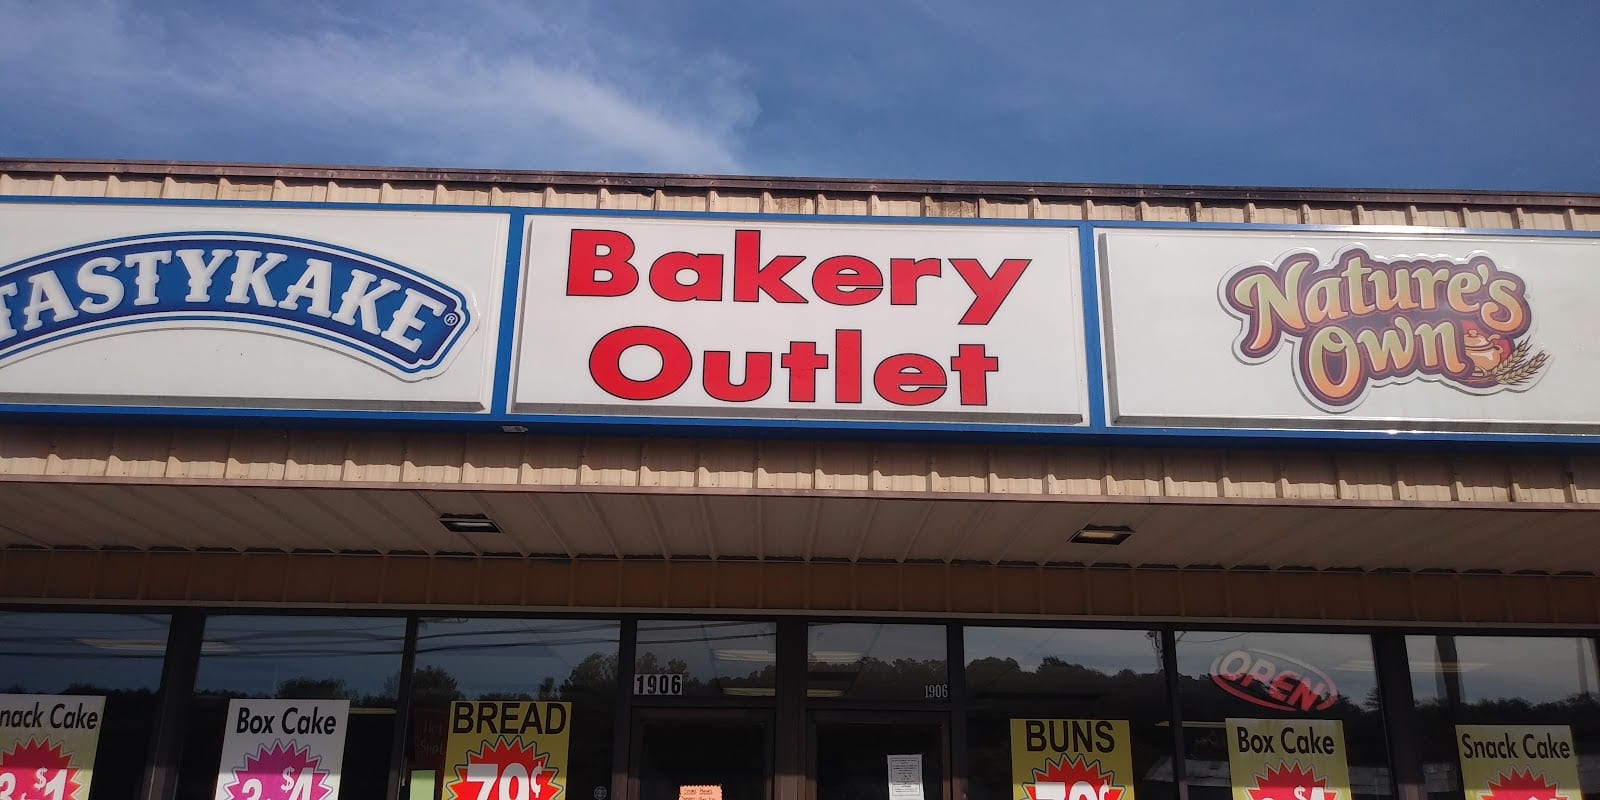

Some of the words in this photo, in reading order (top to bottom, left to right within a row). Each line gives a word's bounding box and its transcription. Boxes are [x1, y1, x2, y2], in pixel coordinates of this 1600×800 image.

[566, 228, 1033, 326] Bakery
[1234, 256, 1524, 350] Nature's
[588, 325, 999, 407] Outlet
[1308, 316, 1467, 398] Own
[637, 674, 682, 695] 1906
[925, 684, 948, 699] 1906
[1219, 650, 1325, 713] OPEN
[50, 703, 98, 729] Cake
[236, 707, 274, 734] Box
[281, 707, 337, 735] Cake
[452, 702, 567, 735] BREAD
[1026, 720, 1116, 753] BUNS
[1237, 726, 1275, 753] Box
[1280, 726, 1335, 755] Cake
[1462, 733, 1517, 758] Snack
[1522, 734, 1570, 760] Cake
